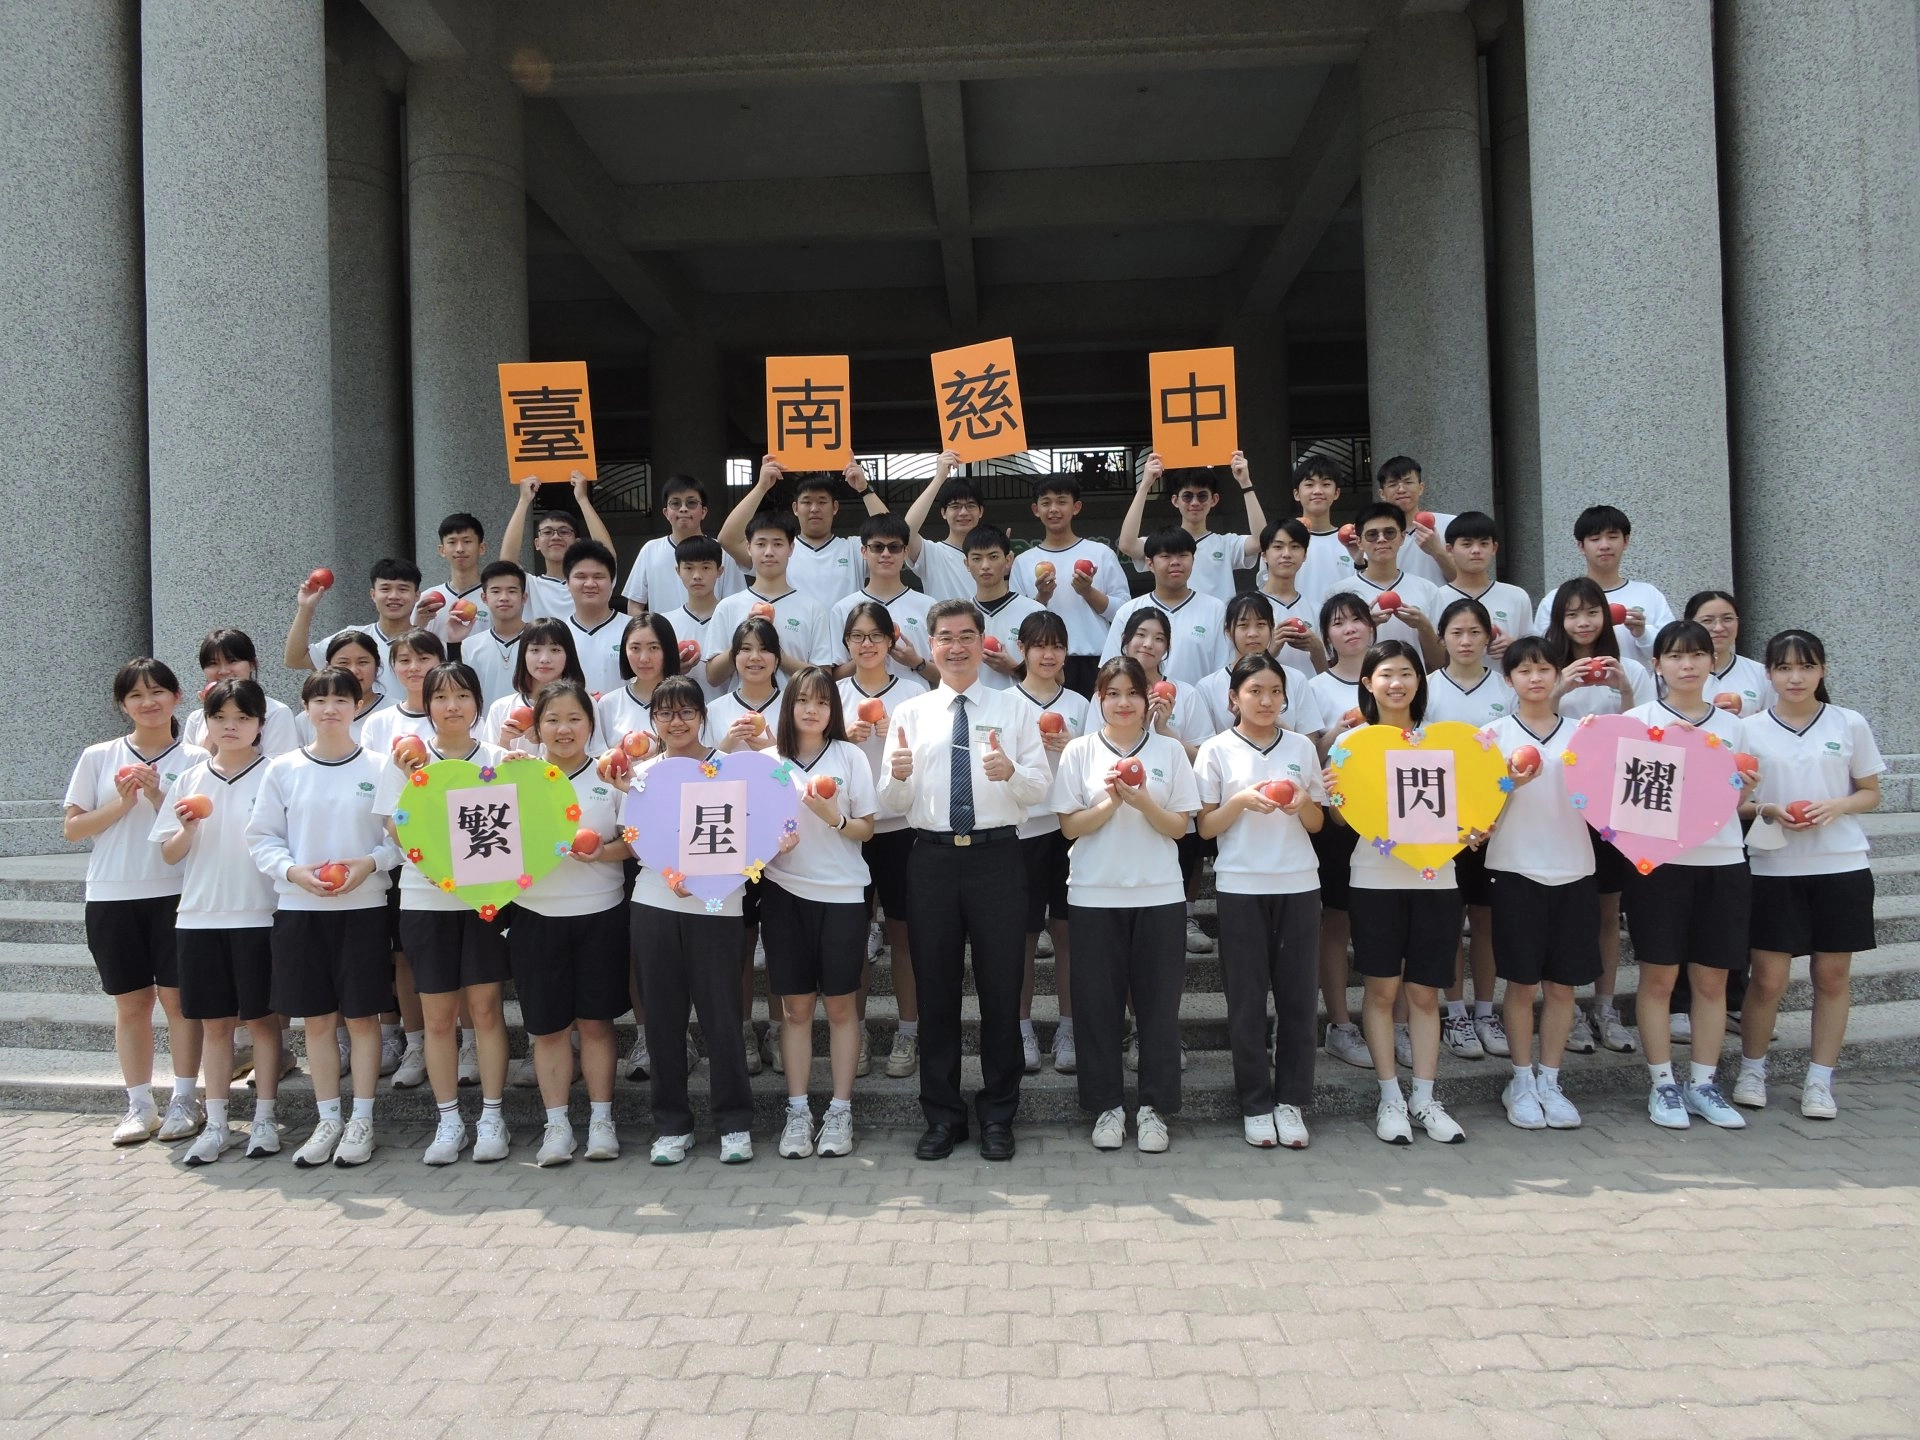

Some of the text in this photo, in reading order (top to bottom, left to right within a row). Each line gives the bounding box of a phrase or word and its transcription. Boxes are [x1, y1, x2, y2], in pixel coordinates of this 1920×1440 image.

[507, 385, 589, 463] 臺
[772, 378, 844, 451] 南
[941, 362, 1018, 442] 慈
[1160, 372, 1227, 447] 中
[1396, 766, 1446, 819] 閃
[1621, 757, 1677, 813] 耀
[457, 802, 512, 860] 繁
[689, 803, 738, 855] 星
